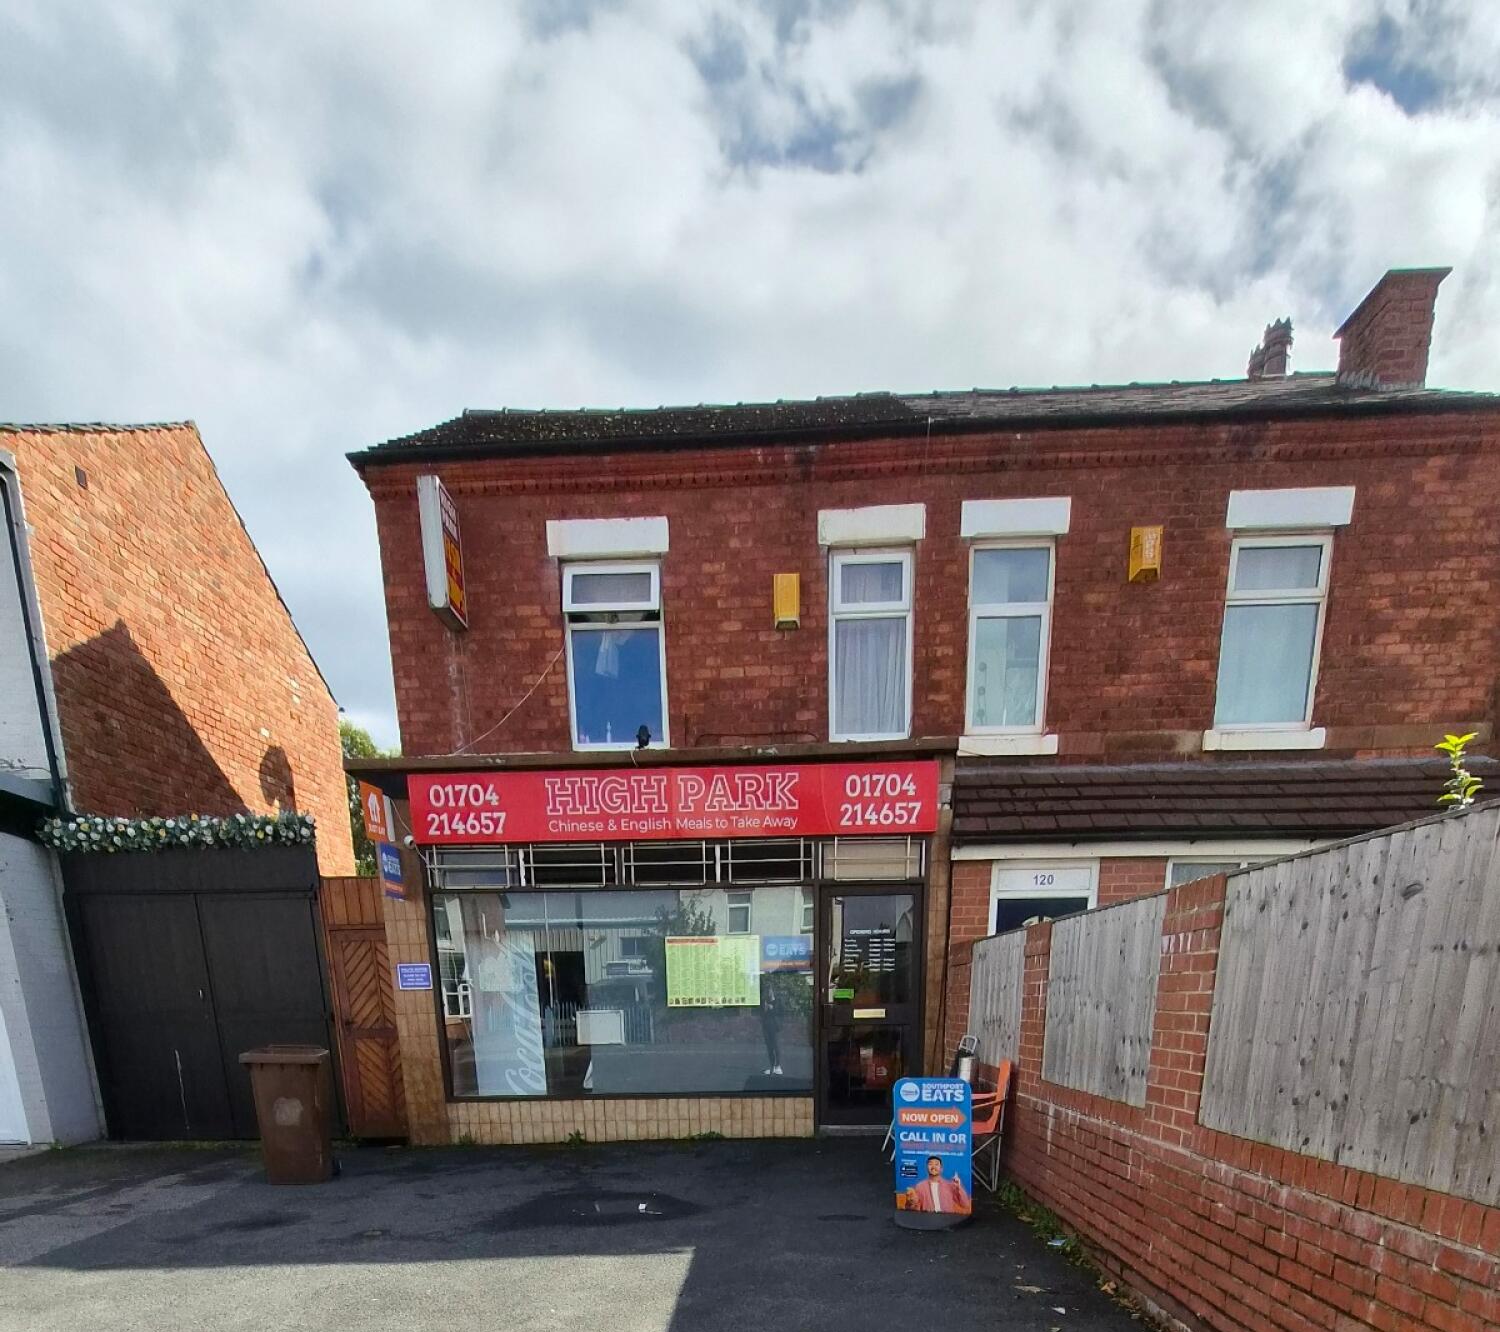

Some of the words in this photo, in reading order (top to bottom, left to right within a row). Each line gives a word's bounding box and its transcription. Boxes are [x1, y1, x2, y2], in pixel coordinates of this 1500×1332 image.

[429, 784, 499, 807] 01704
[545, 776, 669, 815] HIGH
[677, 773, 799, 812] PARK
[845, 773, 917, 797] 01704
[427, 812, 507, 836] 214657
[548, 819, 604, 833] Chinese
[608, 819, 617, 832] &
[621, 817, 672, 834] English
[676, 816, 713, 831] Meals
[715, 817, 729, 830] to
[731, 815, 761, 829] Take
[763, 815, 798, 830] Away
[840, 802, 922, 826] 214657
[1033, 874, 1055, 886] 120
[922, 1089, 965, 1102] EATS
[902, 1113, 928, 1122] NOW
[930, 1114, 959, 1123] OPEN
[899, 1131, 929, 1142] CALL
[932, 1133, 946, 1143] IN
[949, 1133, 966, 1145] OR
